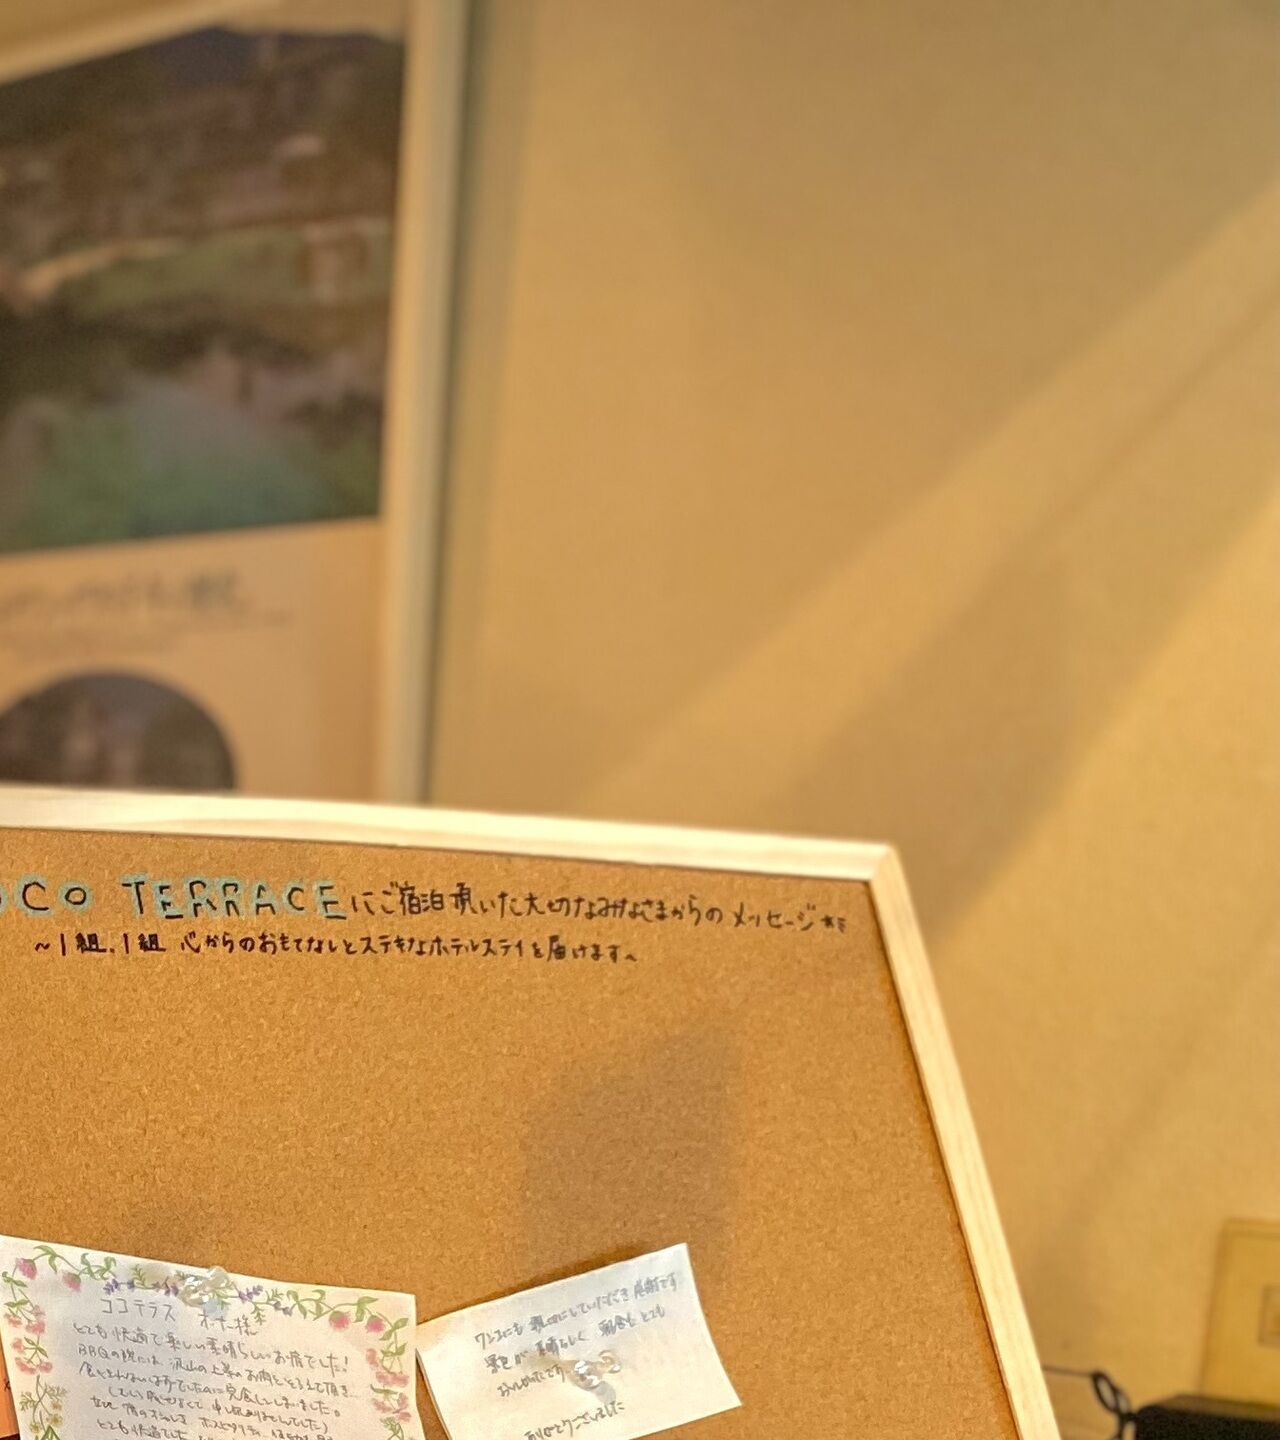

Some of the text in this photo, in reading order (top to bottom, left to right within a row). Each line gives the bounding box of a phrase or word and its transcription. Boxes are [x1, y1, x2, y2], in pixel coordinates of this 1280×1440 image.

[121, 879, 347, 921] TERRACE
[100, 1296, 178, 1323] ココテラス
